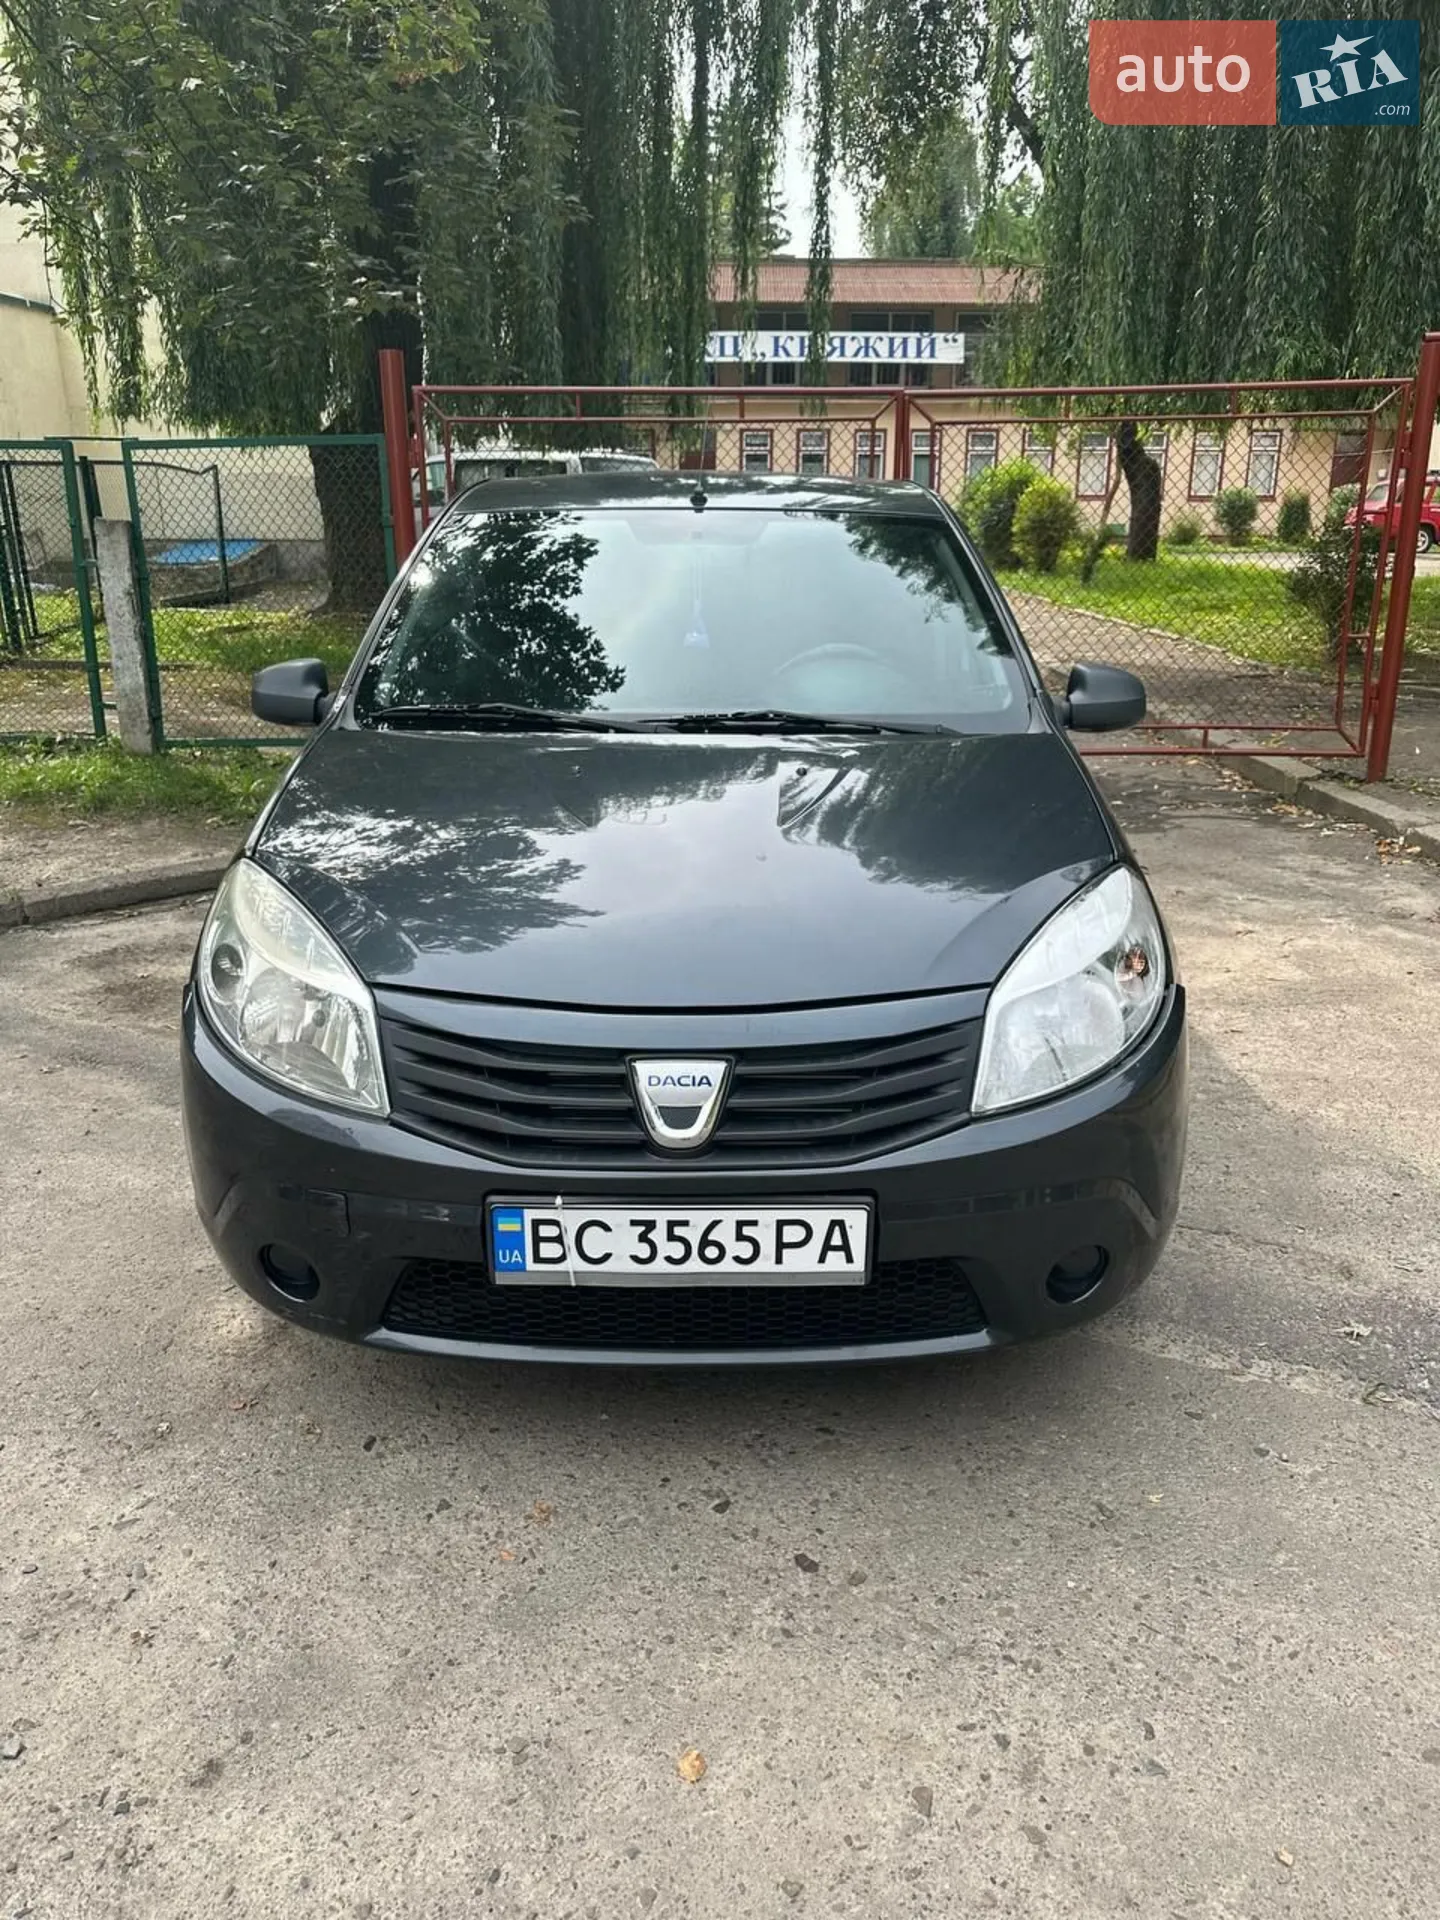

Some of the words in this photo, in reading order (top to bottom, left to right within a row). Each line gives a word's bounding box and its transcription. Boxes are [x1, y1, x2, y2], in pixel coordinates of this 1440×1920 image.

[647, 1075, 713, 1088] DACIA
[530, 1218, 614, 1266] BC
[628, 1218, 761, 1267] 3565
[773, 1218, 855, 1265] PA
[498, 1248, 524, 1264] UA
